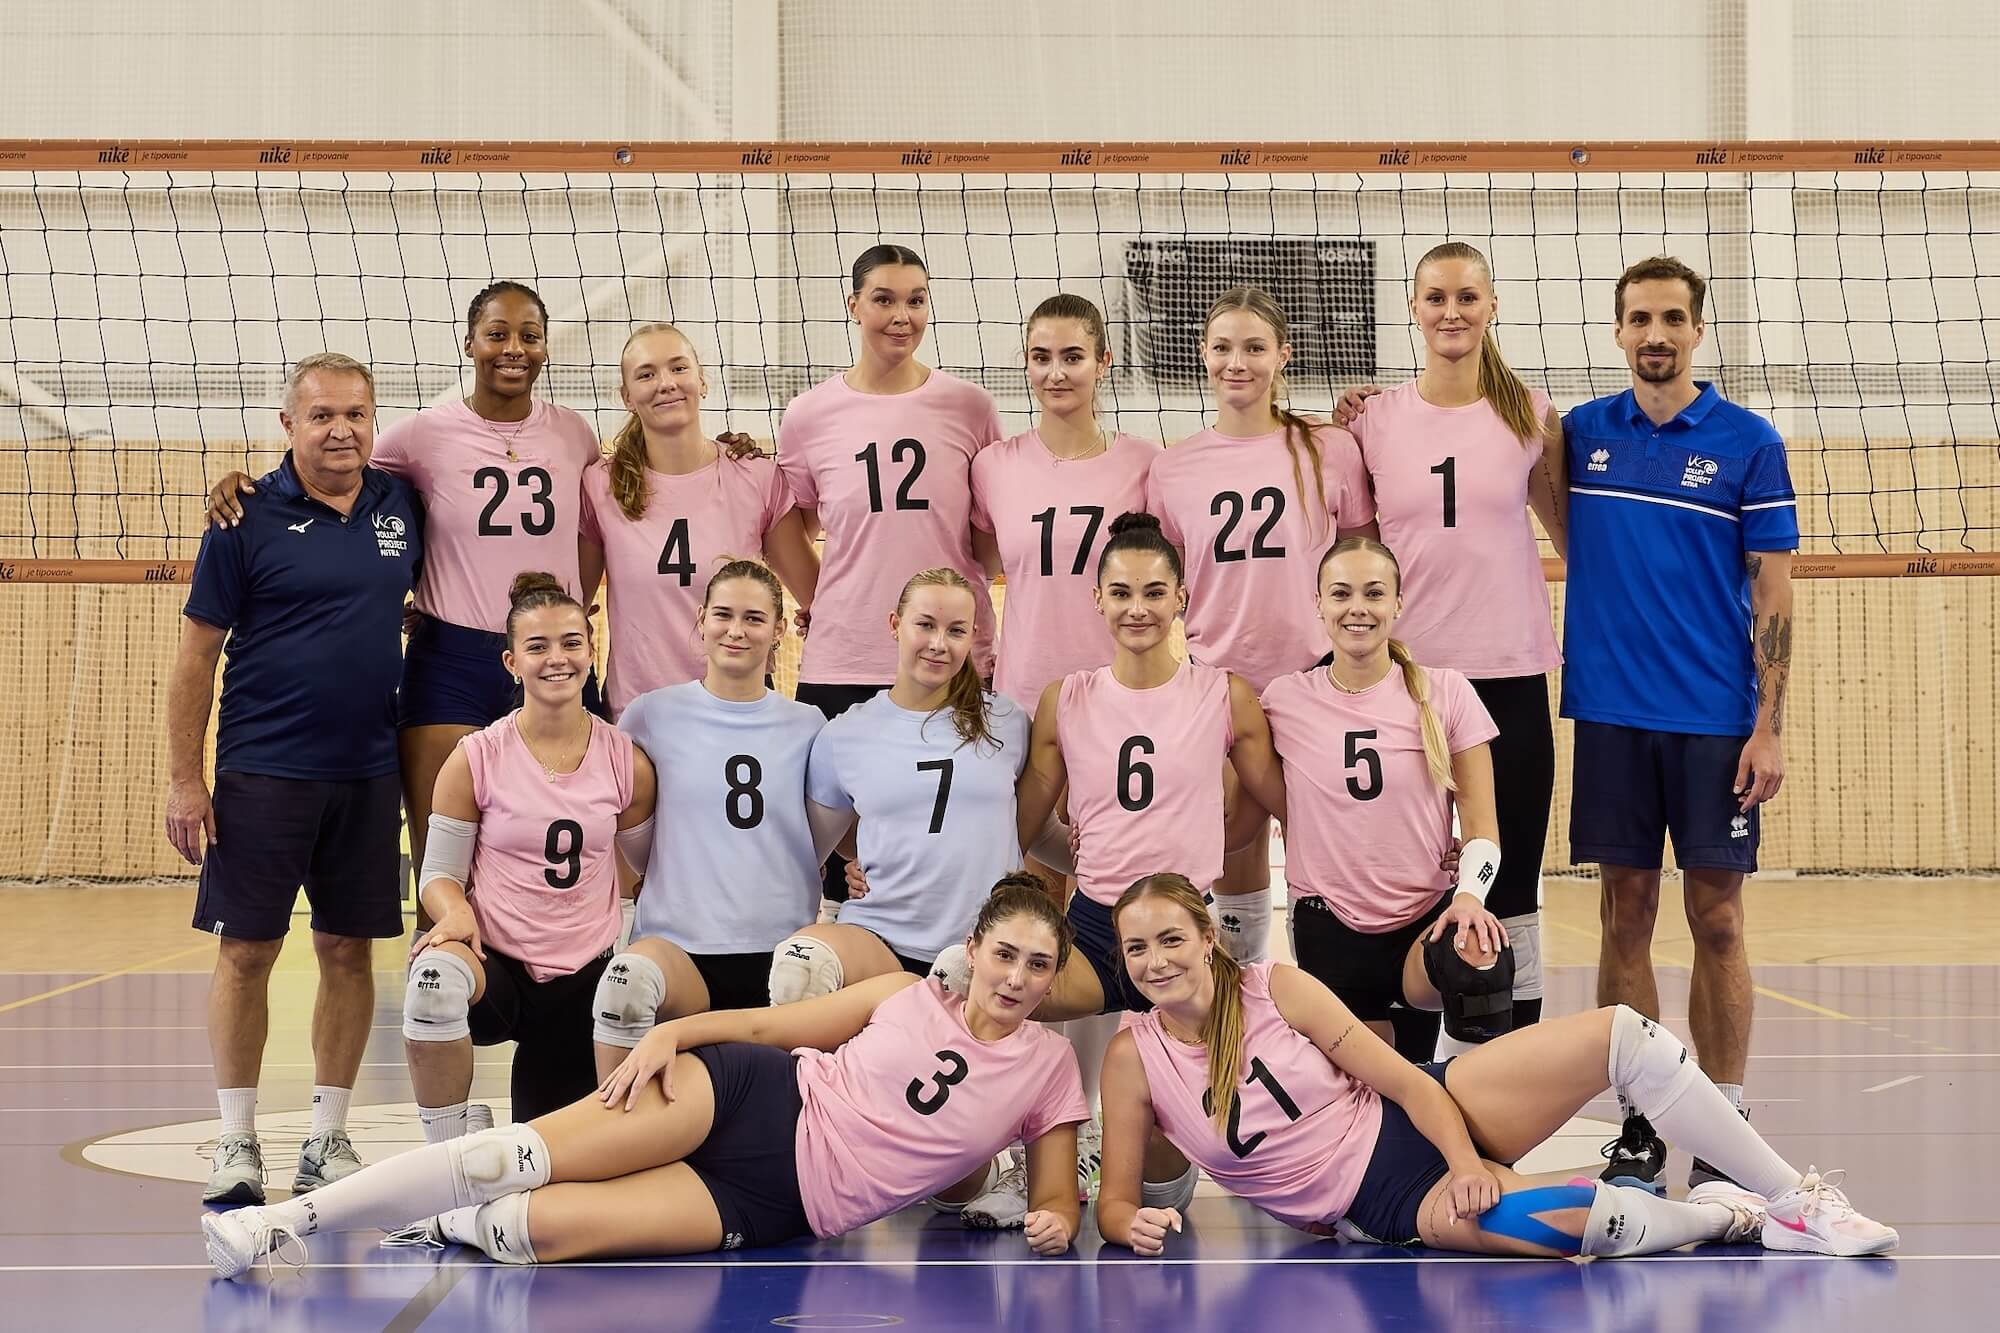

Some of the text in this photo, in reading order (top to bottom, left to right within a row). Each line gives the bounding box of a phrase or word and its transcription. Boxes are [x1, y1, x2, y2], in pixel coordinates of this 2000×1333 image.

[0, 151, 27, 160] ovanie
[98, 147, 187, 164] niké je tipovanie
[260, 147, 348, 164] niké je tipovanie
[420, 147, 511, 164] niké je tipovanie
[741, 148, 829, 165] niké je tipovanie
[901, 148, 989, 165] niké je tipovanie
[1060, 148, 1149, 165] niké je tipovanie
[1220, 148, 1308, 165] niké je tipovanie
[1379, 148, 1467, 165] niké je tipovanie
[1696, 148, 1783, 164] niké je tipovanie
[1854, 147, 1942, 164] niké je tipovanie
[855, 439, 929, 513] 12
[1682, 473, 1712, 485] PROJECT
[1685, 467, 1705, 476] VOLLEY
[1430, 456, 1456, 528] 1
[474, 466, 555, 537] 23
[1210, 486, 1286, 563] 22
[374, 530, 397, 538] VOLLEY
[1031, 505, 1105, 577] 17
[377, 539, 407, 550] PROJECT
[657, 518, 697, 587] 4
[0, 562, 73, 580] ké je tipovanie
[144, 564, 177, 580] niké
[1799, 564, 1836, 575] tipovanie
[1907, 557, 1995, 573] niké je tipovanie
[1117, 735, 1155, 812] 6
[1344, 729, 1384, 801] 5
[725, 754, 764, 830] 8
[916, 758, 954, 834] 7
[544, 819, 584, 889] 9
[418, 981, 440, 990] errea
[905, 1050, 969, 1116] 3
[1202, 1056, 1303, 1160] 21
